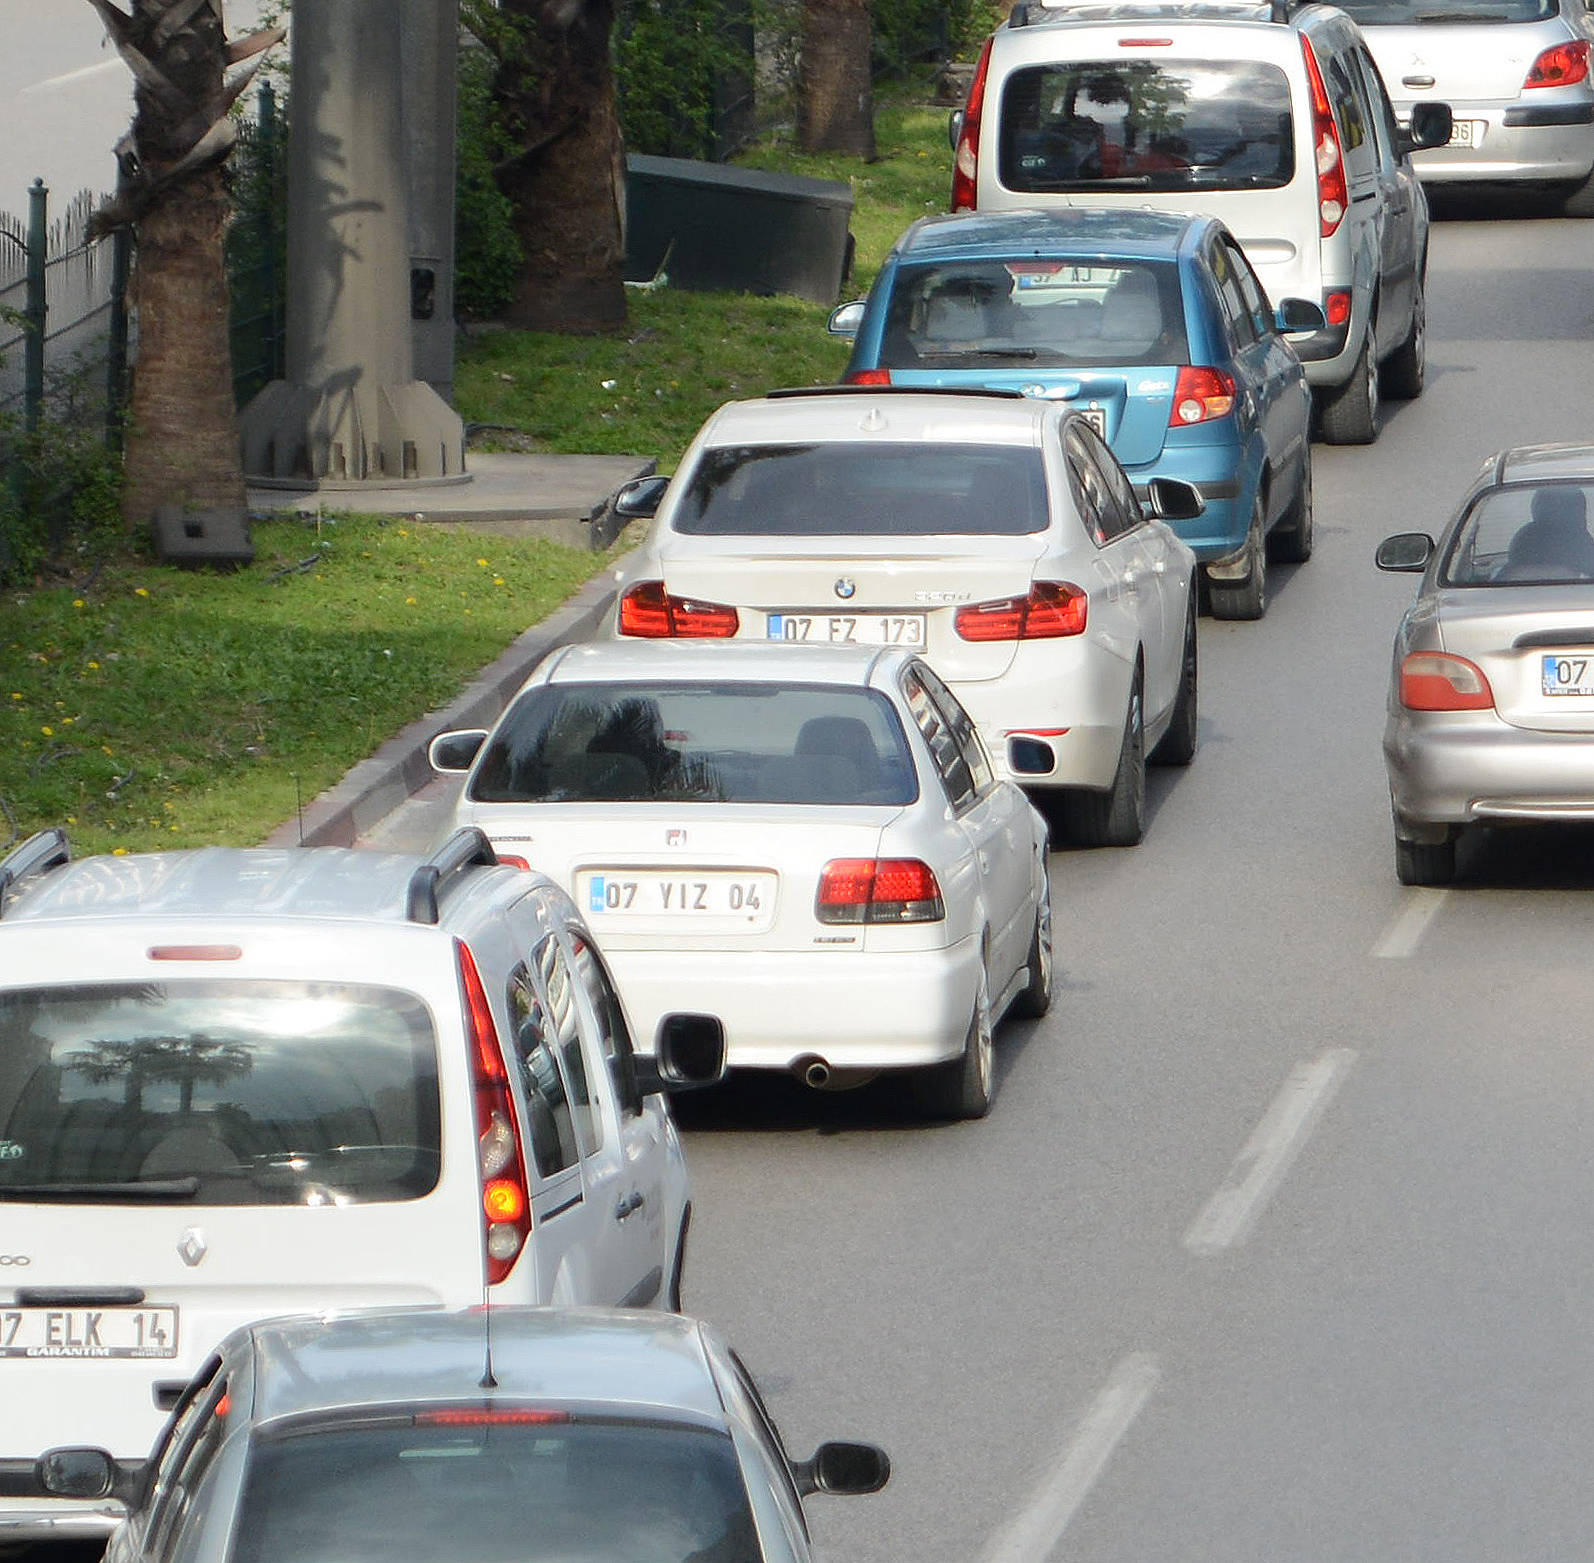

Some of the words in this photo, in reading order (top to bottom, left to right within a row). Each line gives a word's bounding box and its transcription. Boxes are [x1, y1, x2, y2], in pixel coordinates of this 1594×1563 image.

[784, 618, 813, 642] 07
[880, 618, 920, 644] 173
[1557, 659, 1588, 685] 07
[606, 882, 638, 910] 07
[660, 882, 709, 910] YIZ
[729, 882, 761, 910] 04
[0, 1311, 24, 1347] 7
[46, 1311, 103, 1347] ELK
[132, 1311, 167, 1347] 14
